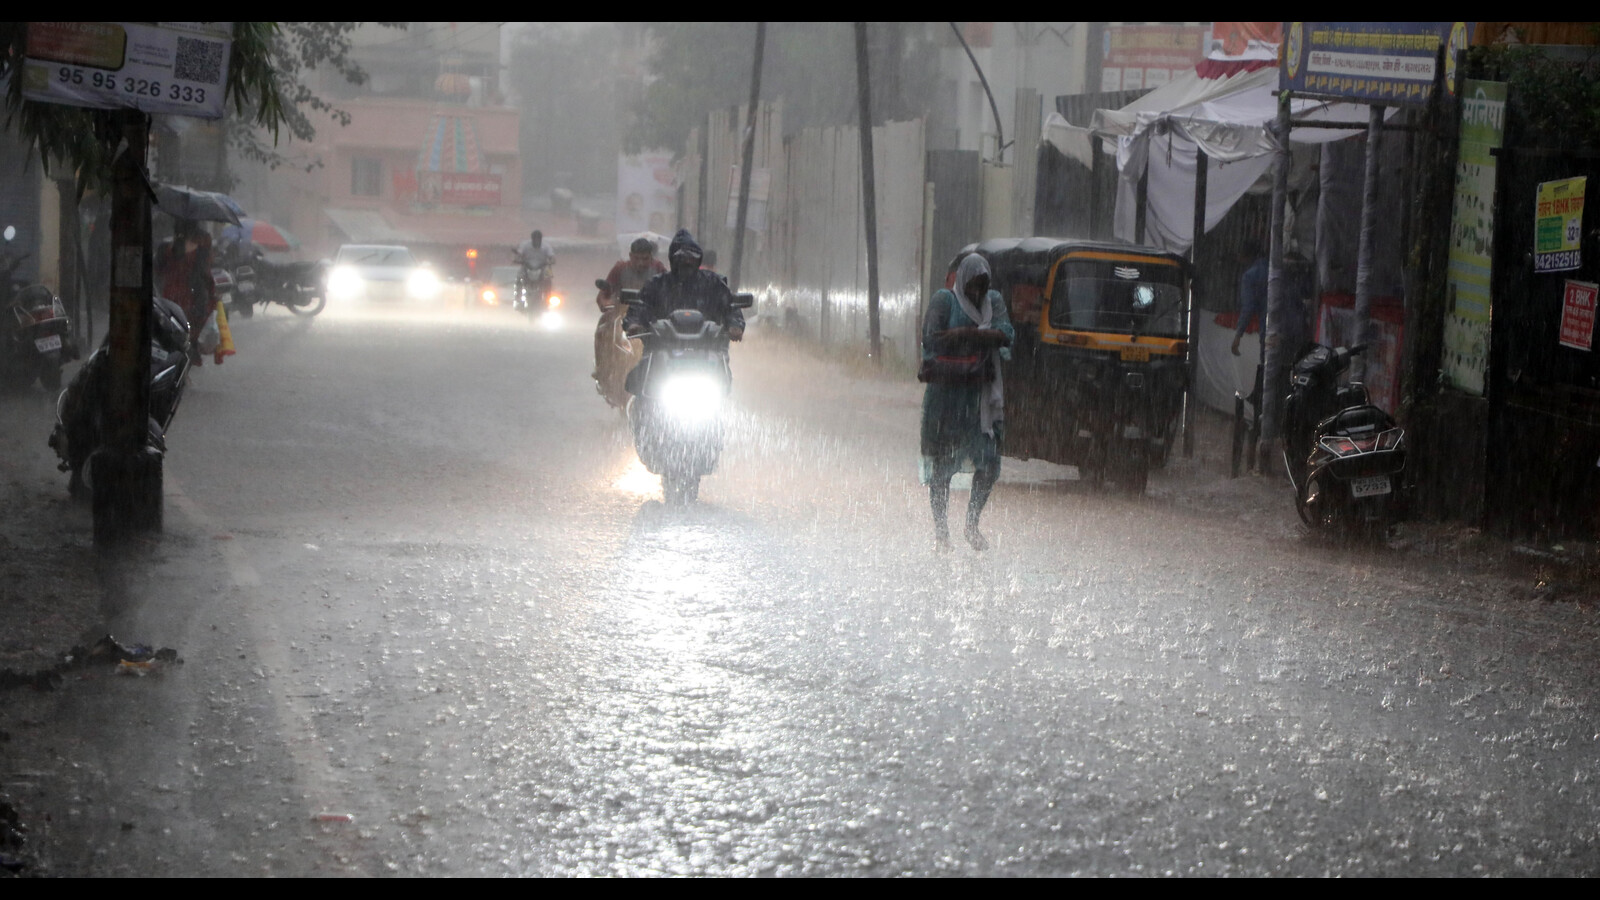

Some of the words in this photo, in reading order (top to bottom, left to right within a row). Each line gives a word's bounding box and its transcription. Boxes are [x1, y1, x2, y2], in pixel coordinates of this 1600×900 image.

[58, 67, 84, 85] 95
[92, 71, 117, 90] 95
[124, 77, 161, 97] 326
[169, 84, 206, 104] 333
[1567, 226, 1576, 241] 32
[1569, 289, 1575, 303] 2
[1575, 289, 1592, 307] BHK
